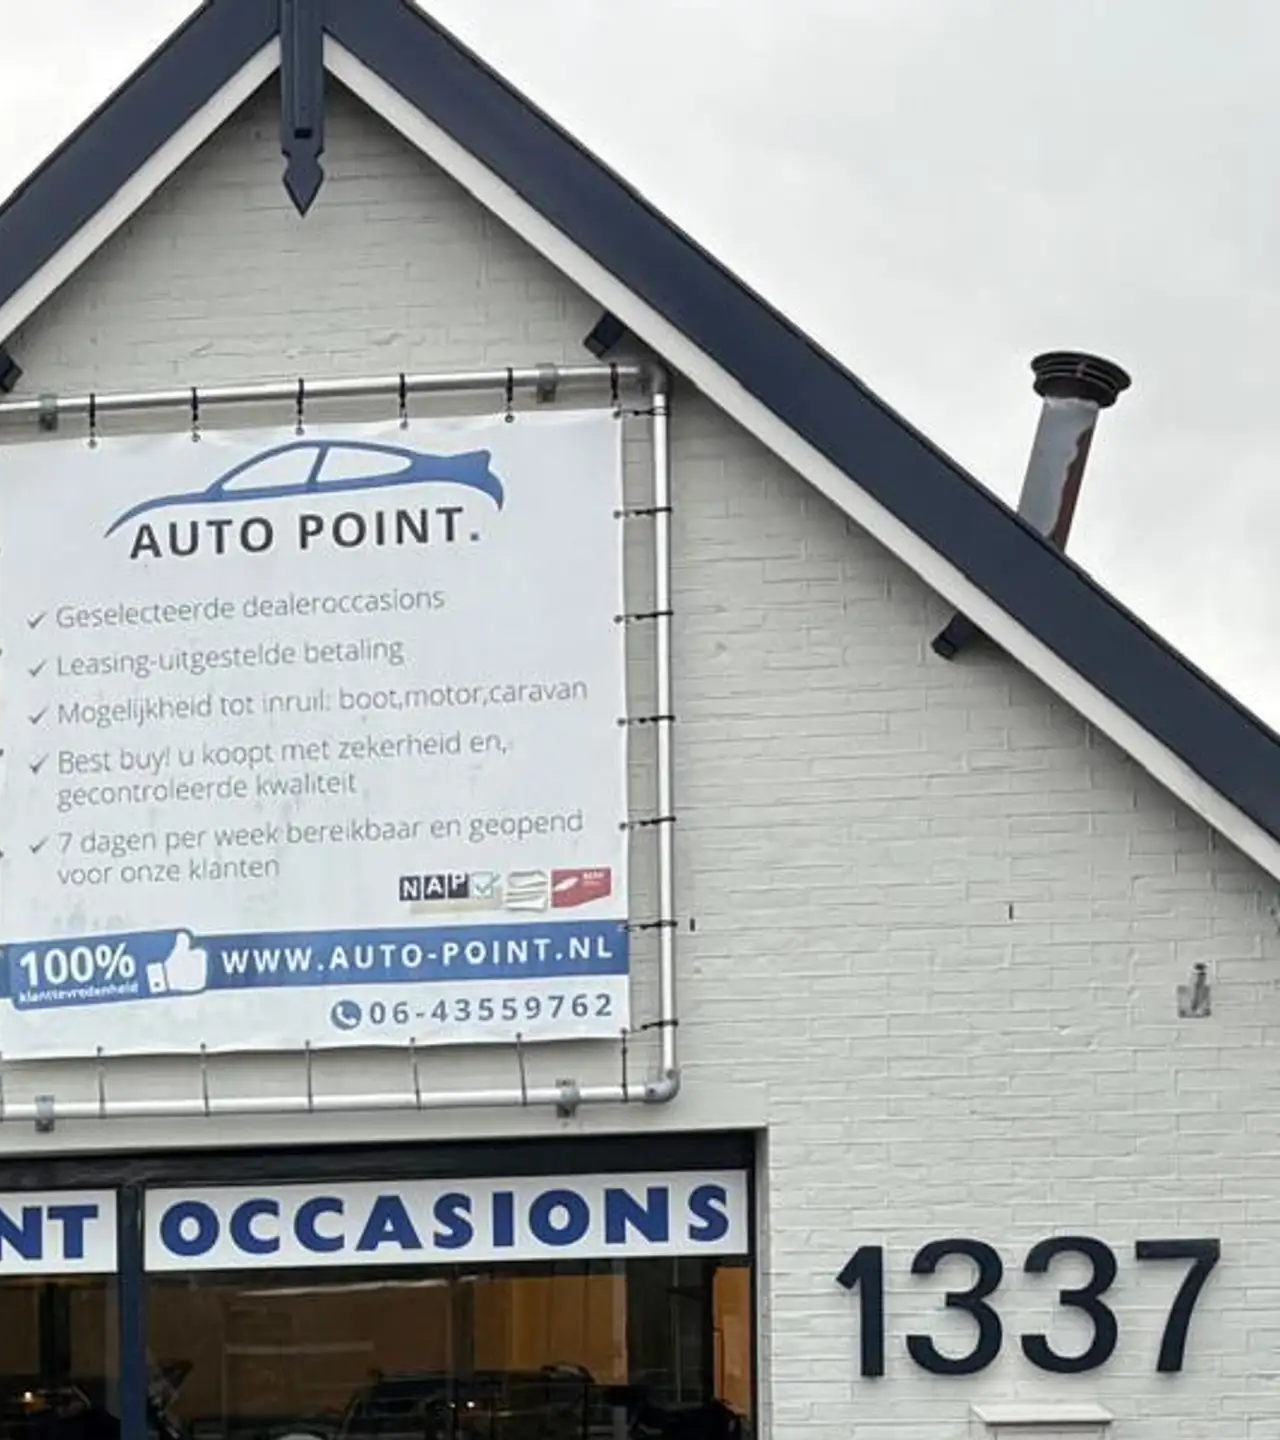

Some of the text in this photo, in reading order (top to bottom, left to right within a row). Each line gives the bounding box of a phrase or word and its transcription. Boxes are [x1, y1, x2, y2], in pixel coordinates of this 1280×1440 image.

[129, 517, 274, 561] AUTO
[55, 588, 447, 630] Geselecteerde dealeroccasions
[56, 636, 406, 679] Leasing-uitgestelde betaling
[57, 679, 589, 728] Mogelijkheid tot inruil: boot,motor,caravan
[58, 750, 111, 775] Best
[120, 748, 171, 779] buy!
[179, 752, 195, 768] u
[202, 744, 275, 772] koopt
[281, 741, 331, 762] met
[337, 730, 462, 760] zekerheid
[57, 771, 358, 813] gecontroleerde kwaliteit
[58, 808, 584, 859] 7 dagen per week bereikbaar en geopend
[58, 856, 281, 887] voor onze klanten
[399, 872, 470, 902] NAP
[19, 936, 614, 988] 100% WWW.AUTO-POINT.NL
[369, 993, 613, 1026] 06-43559762
[158, 1184, 730, 1257] OCCASIONS
[835, 1235, 1221, 1377] 1337
